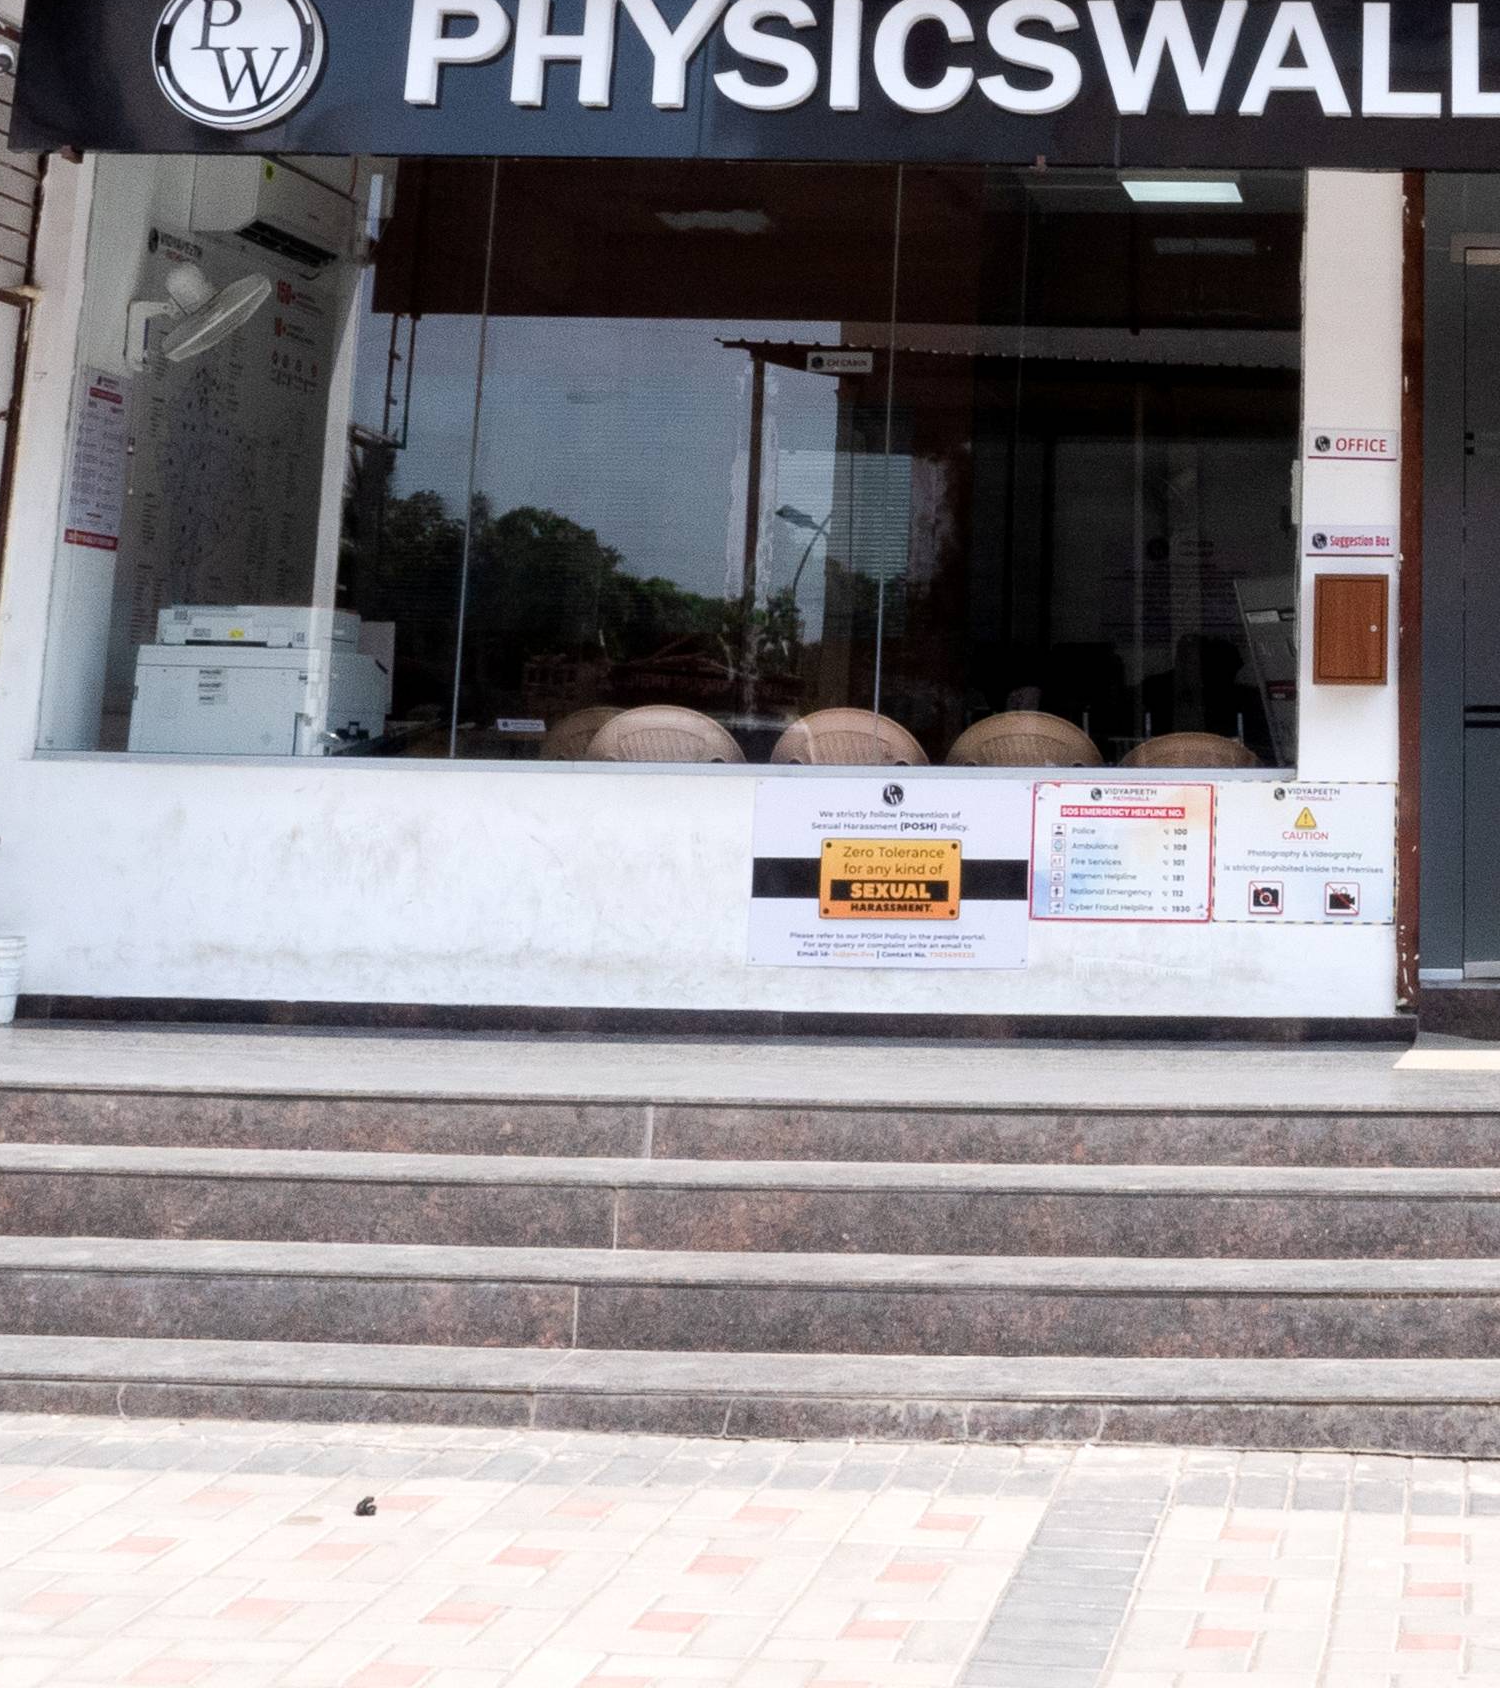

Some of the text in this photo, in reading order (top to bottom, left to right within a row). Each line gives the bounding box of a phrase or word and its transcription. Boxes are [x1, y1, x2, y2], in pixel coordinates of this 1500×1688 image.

[1335, 437, 1388, 454] OFFICE
[1329, 534, 1391, 549] Suggestion Box
[1103, 787, 1158, 796] VIDYAPEETH
[1287, 787, 1341, 796] VIDYAPEETH
[836, 810, 949, 821] strictly follow Prevention
[1079, 808, 1167, 817] EMERGENCY HELPLINE
[811, 821, 938, 833] Sexual Harassment (POSH)
[1281, 831, 1330, 841] CAUTION
[842, 845, 946, 859] Zero Tolerance
[1071, 842, 1119, 851] Ambulance
[1247, 849, 1363, 860] Photography Videography
[843, 862, 945, 878] for any kind of
[1232, 863, 1384, 874] strictly prohibited inside Premises
[849, 882, 933, 900] SEXUAL
[1106, 888, 1152, 898] Emergency
[849, 903, 935, 913] HARASSMENT.
[1120, 904, 1154, 913] Helpline
